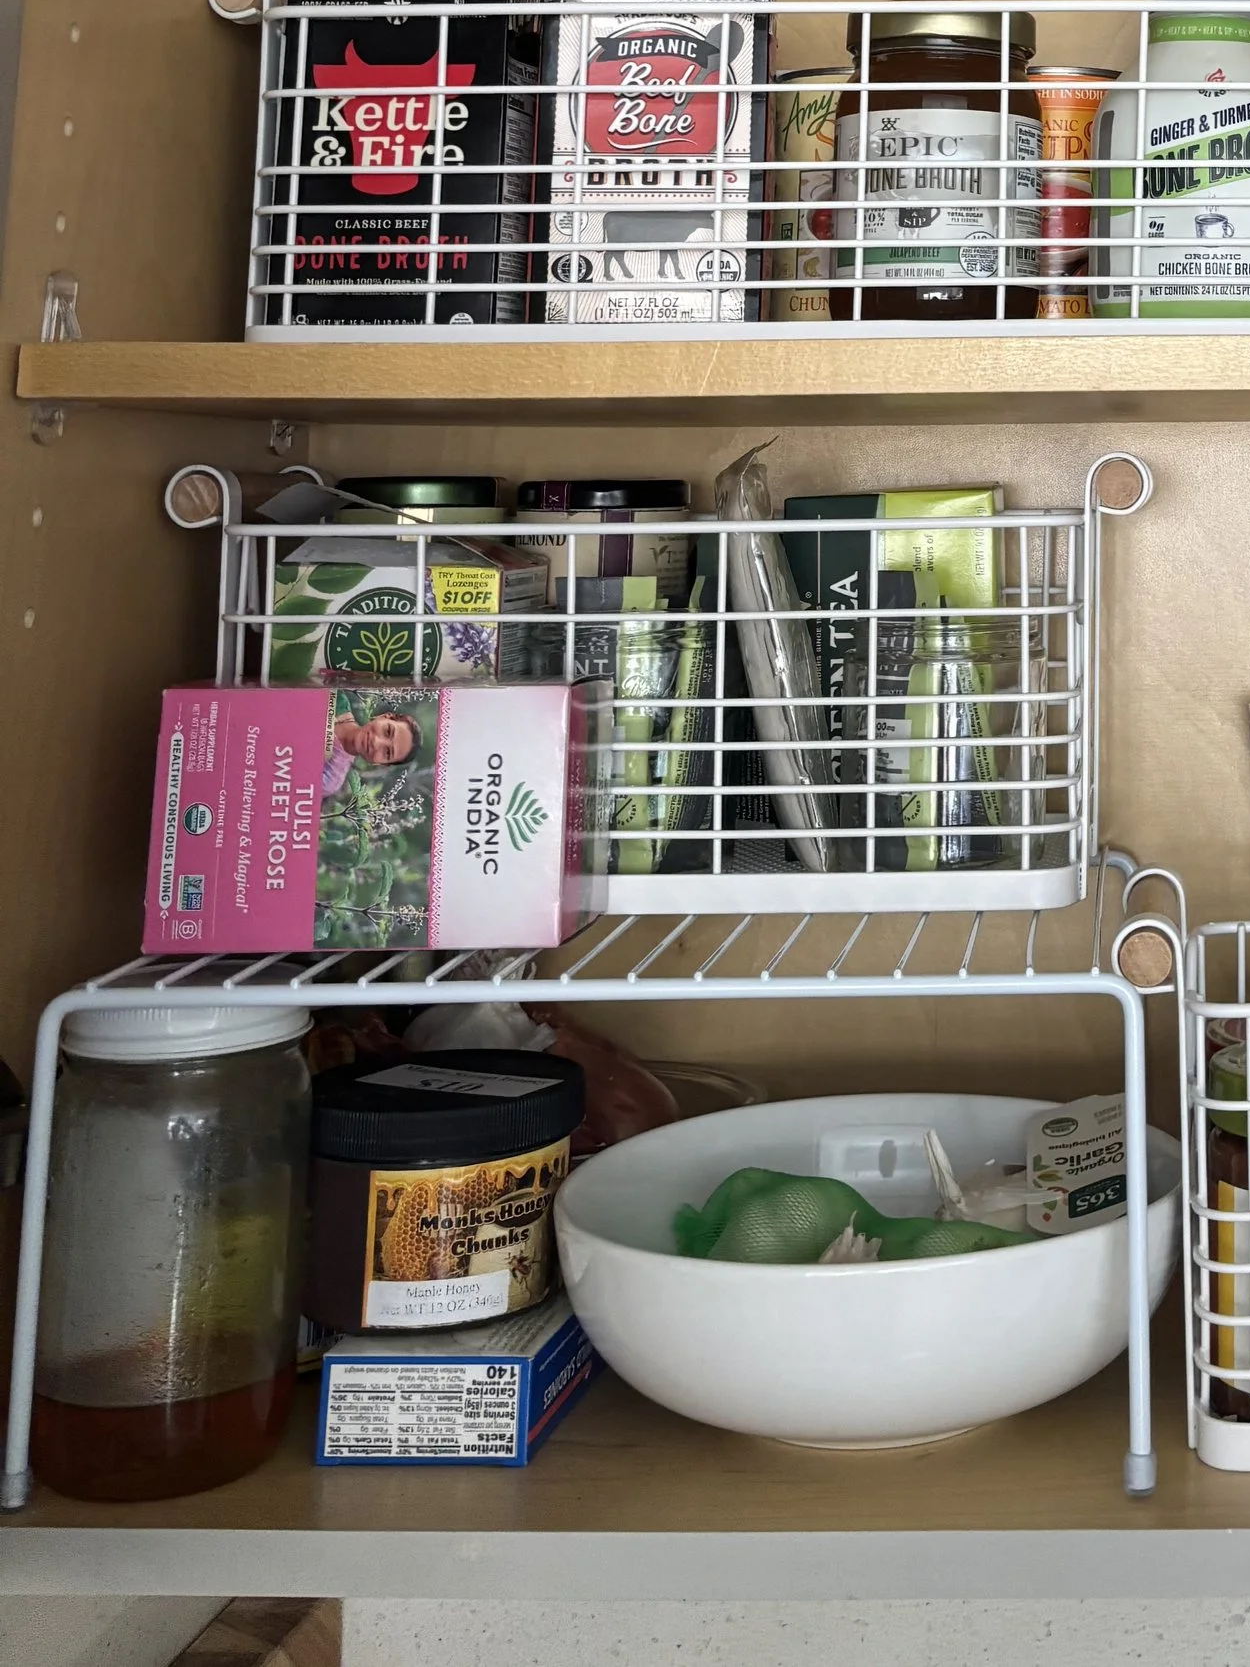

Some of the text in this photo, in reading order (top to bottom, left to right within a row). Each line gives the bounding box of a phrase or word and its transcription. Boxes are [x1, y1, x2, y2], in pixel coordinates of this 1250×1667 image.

[617, 38, 698, 59] ORGANIC
[617, 61, 697, 103] Beef
[311, 95, 469, 133] Kettle
[607, 98, 695, 135] Bone
[1150, 118, 1196, 147] GINGER
[1199, 114, 1210, 132] &
[310, 134, 466, 168] & Fire
[879, 136, 958, 157] EPIC
[587, 158, 716, 187] BROTH
[1143, 144, 1201, 200] BONE
[335, 219, 429, 230] CLASSIC BEEF
[706, 260, 731, 270] UDA
[1158, 262, 1202, 277] CHICKEN
[1204, 262, 1232, 276] BONE
[1184, 252, 1242, 261] ORGANIC
[608, 297, 679, 308] NET 17 FL OZ
[446, 579, 488, 589] Lozenges
[462, 591, 493, 605] OFF
[244, 725, 260, 768] Stress
[238, 769, 257, 833] Relieving
[161, 738, 182, 903] HEALTHY CONSCIOUS LIVING
[265, 745, 293, 891] SWEET ROSE
[292, 784, 314, 851] TULSI
[465, 778, 484, 856] INDIA
[483, 753, 504, 876] ORGANIC
[239, 836, 251, 847] &
[1054, 1141, 1124, 1167] Garlic
[1065, 1151, 1125, 1176] Organic
[1075, 1183, 1121, 1212] 365
[419, 1194, 551, 1233] Monks Honey
[450, 1227, 530, 1258] Chunks
[406, 1281, 482, 1300] Maple Honey
[487, 1365, 517, 1379] 140
[466, 1386, 516, 1398] Calories
[464, 1410, 516, 1420] Serving size
[463, 1443, 514, 1455] Nutrition
[477, 1432, 514, 1443] Facts
